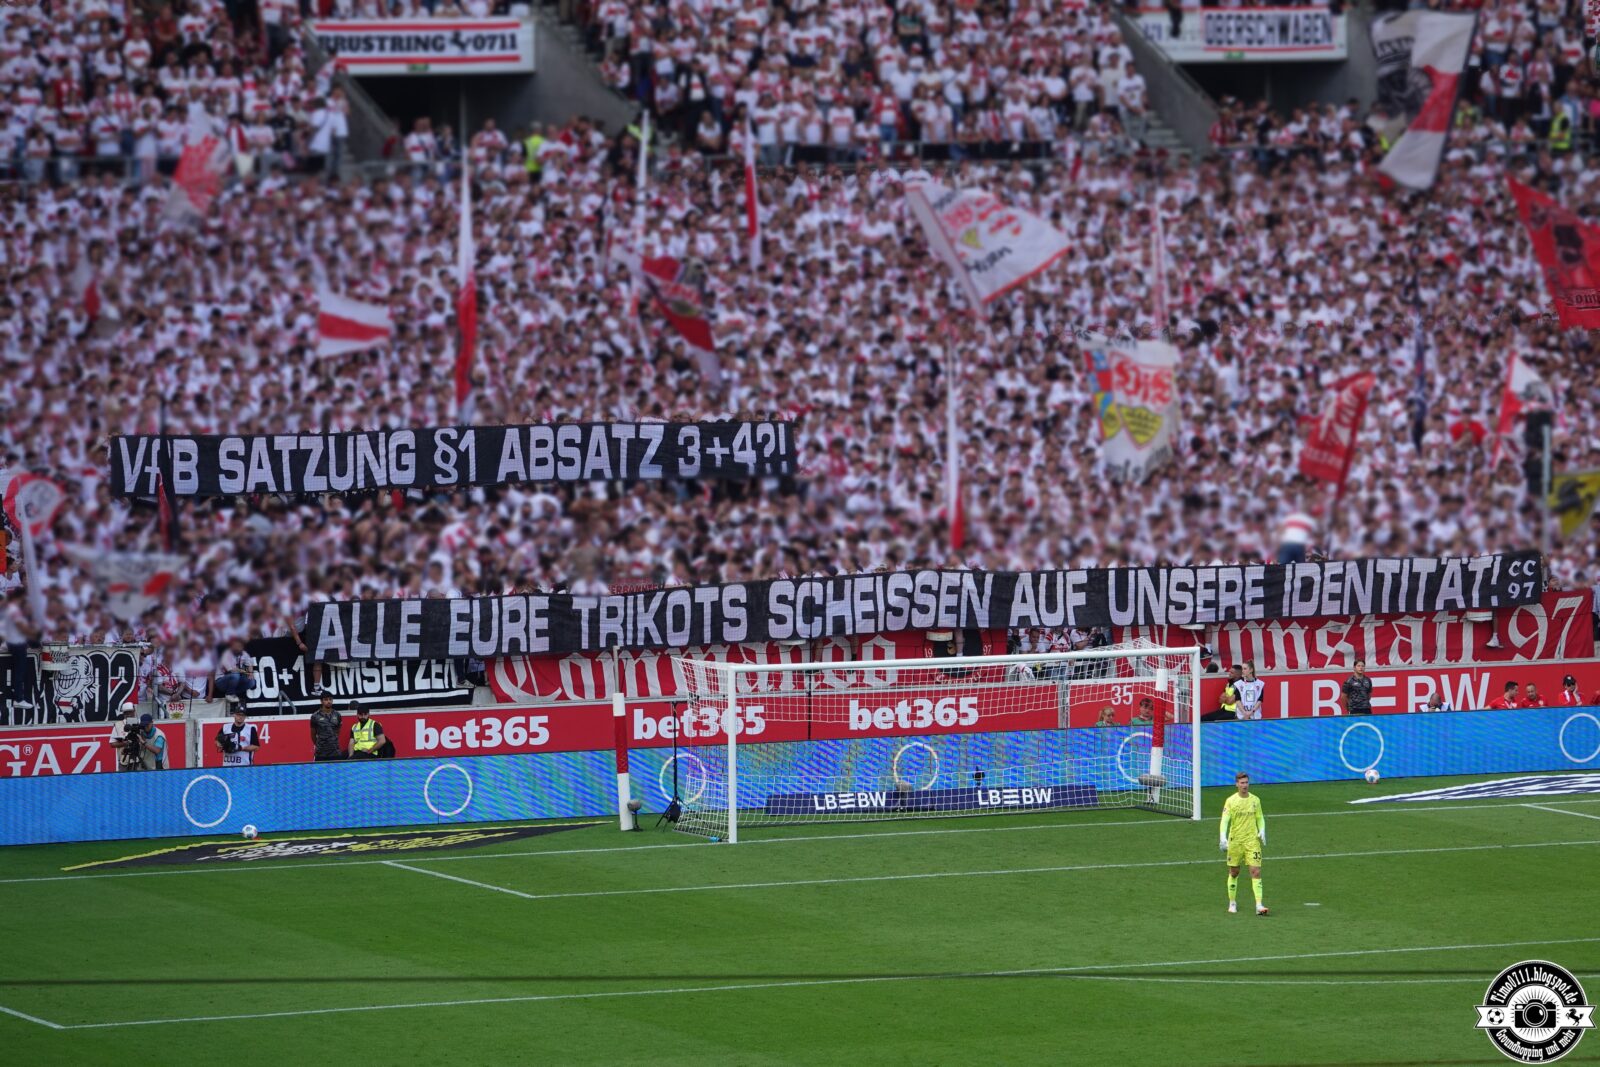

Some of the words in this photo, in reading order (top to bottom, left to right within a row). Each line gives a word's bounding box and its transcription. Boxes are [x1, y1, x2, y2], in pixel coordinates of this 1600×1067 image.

[472, 33, 518, 50] 0711
[1205, 13, 1332, 45] OBERSCHWABEN
[119, 437, 199, 495] VfB
[218, 430, 416, 493] SATZUNG
[433, 428, 477, 484] §1
[497, 424, 664, 482] ABSATZ
[1508, 559, 1537, 577] CC
[1507, 581, 1535, 600] 97
[314, 600, 422, 660] ALLE
[448, 595, 551, 656] EURE
[572, 584, 748, 650] TRIKOTS
[768, 570, 994, 640] SCHEISSEN
[1009, 569, 1088, 627] AUF
[1108, 565, 1265, 627] UNSERE
[1282, 555, 1502, 618] IDENTITÄT!
[1508, 595, 1584, 662] 97
[1110, 685, 1134, 705] 35
[633, 706, 766, 740] bet365
[849, 697, 979, 730] bet365
[415, 716, 550, 750] bet365
